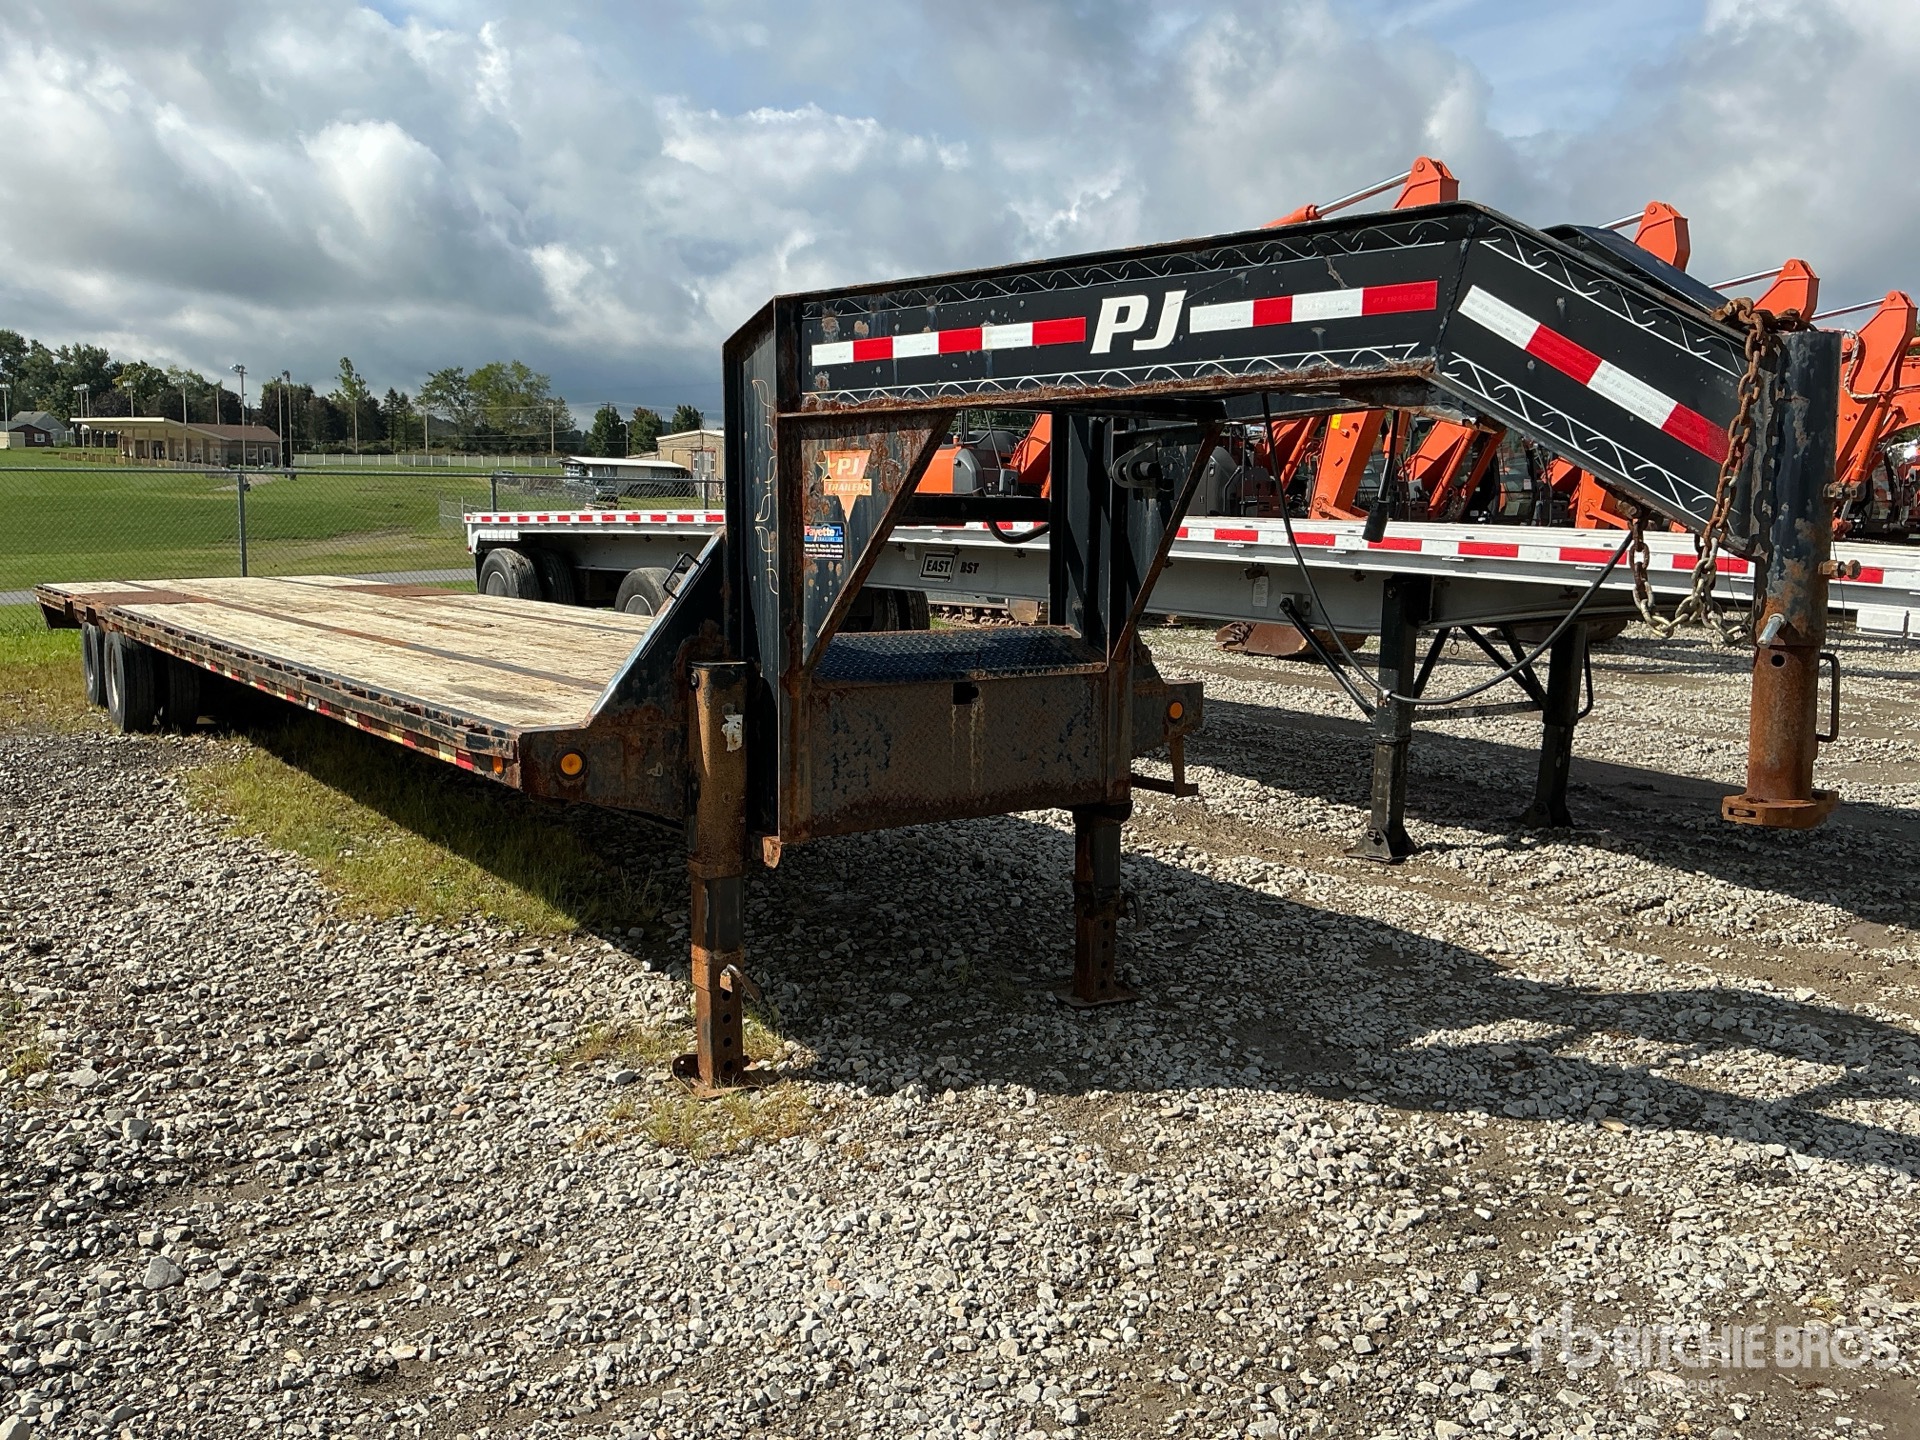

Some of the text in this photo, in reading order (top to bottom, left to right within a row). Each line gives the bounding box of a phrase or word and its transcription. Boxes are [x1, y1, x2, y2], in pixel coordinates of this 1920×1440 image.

[1090, 289, 1187, 354] PJ
[836, 457, 861, 475] PJ
[926, 560, 980, 574] EAST BST
